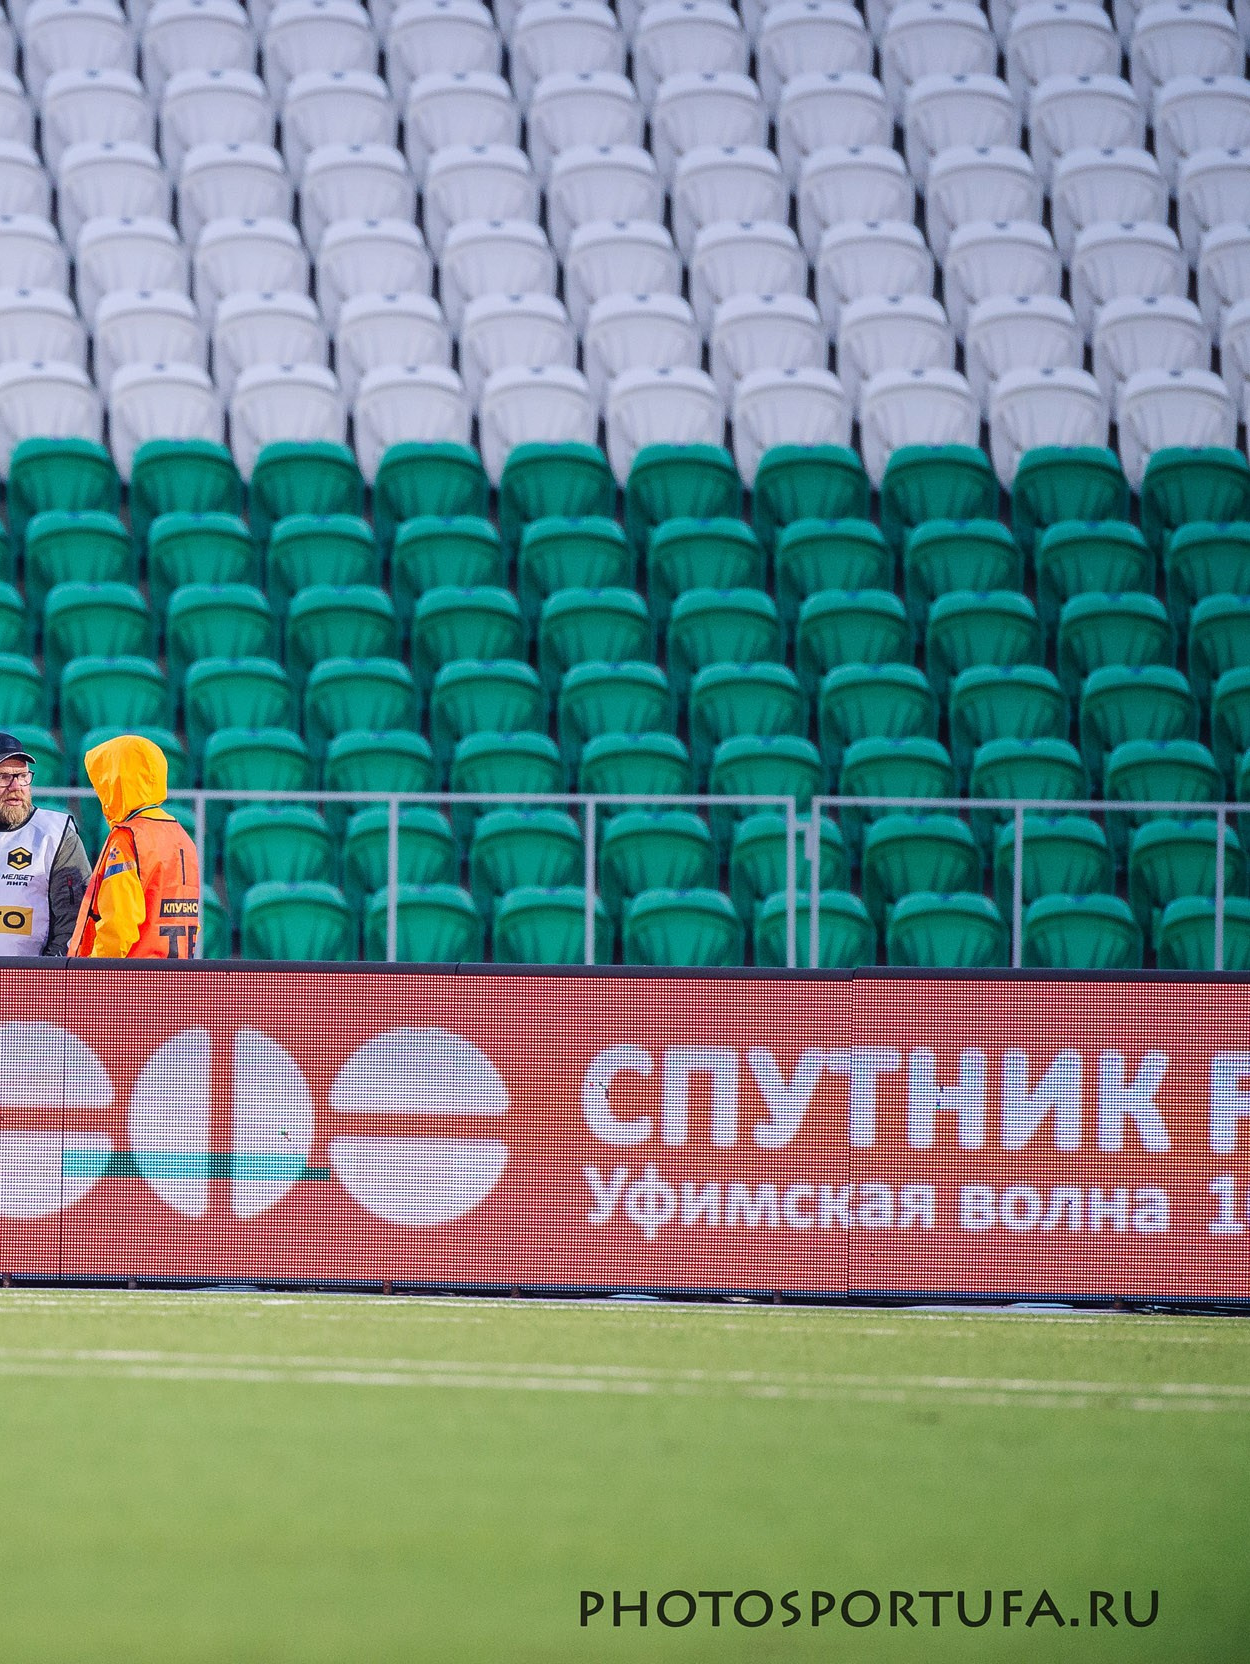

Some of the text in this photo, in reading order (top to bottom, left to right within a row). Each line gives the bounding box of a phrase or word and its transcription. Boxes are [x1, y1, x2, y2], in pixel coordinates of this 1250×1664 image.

[580, 1044, 1171, 1153] СПУТНИК
[583, 1164, 937, 1241] Уфимская
[959, 1182, 1171, 1234] волна
